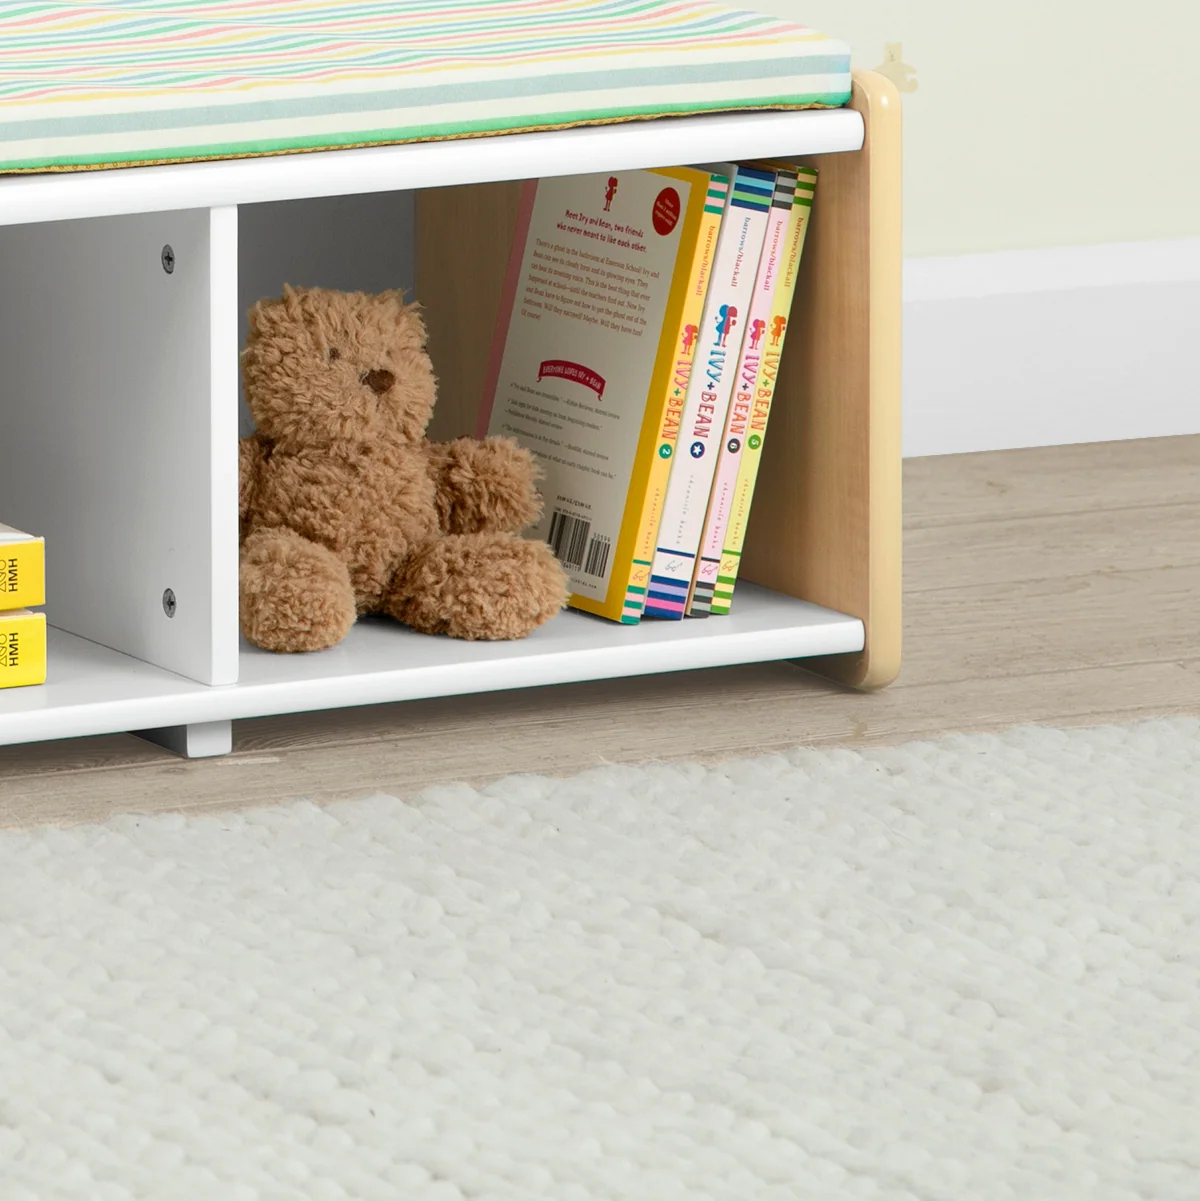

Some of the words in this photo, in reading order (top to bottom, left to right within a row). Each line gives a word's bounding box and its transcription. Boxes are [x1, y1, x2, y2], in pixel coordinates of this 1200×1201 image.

[557, 221, 567, 231] who
[567, 225, 583, 235] never
[600, 233, 606, 242] to
[589, 216, 598, 226] and
[614, 224, 624, 233] two
[625, 225, 644, 238] friends
[696, 226, 716, 296] barrows/blackall
[730, 216, 752, 288] barrows/blackall
[764, 220, 784, 291] barrows/blackall
[784, 217, 804, 288] barrows/blackall
[661, 396, 684, 440] BEAN
[693, 391, 718, 439] BEAN
[730, 392, 752, 435] BEAN
[750, 388, 772, 431] BEAN
[8, 558, 18, 592] HMH
[9, 632, 18, 667] HMH
